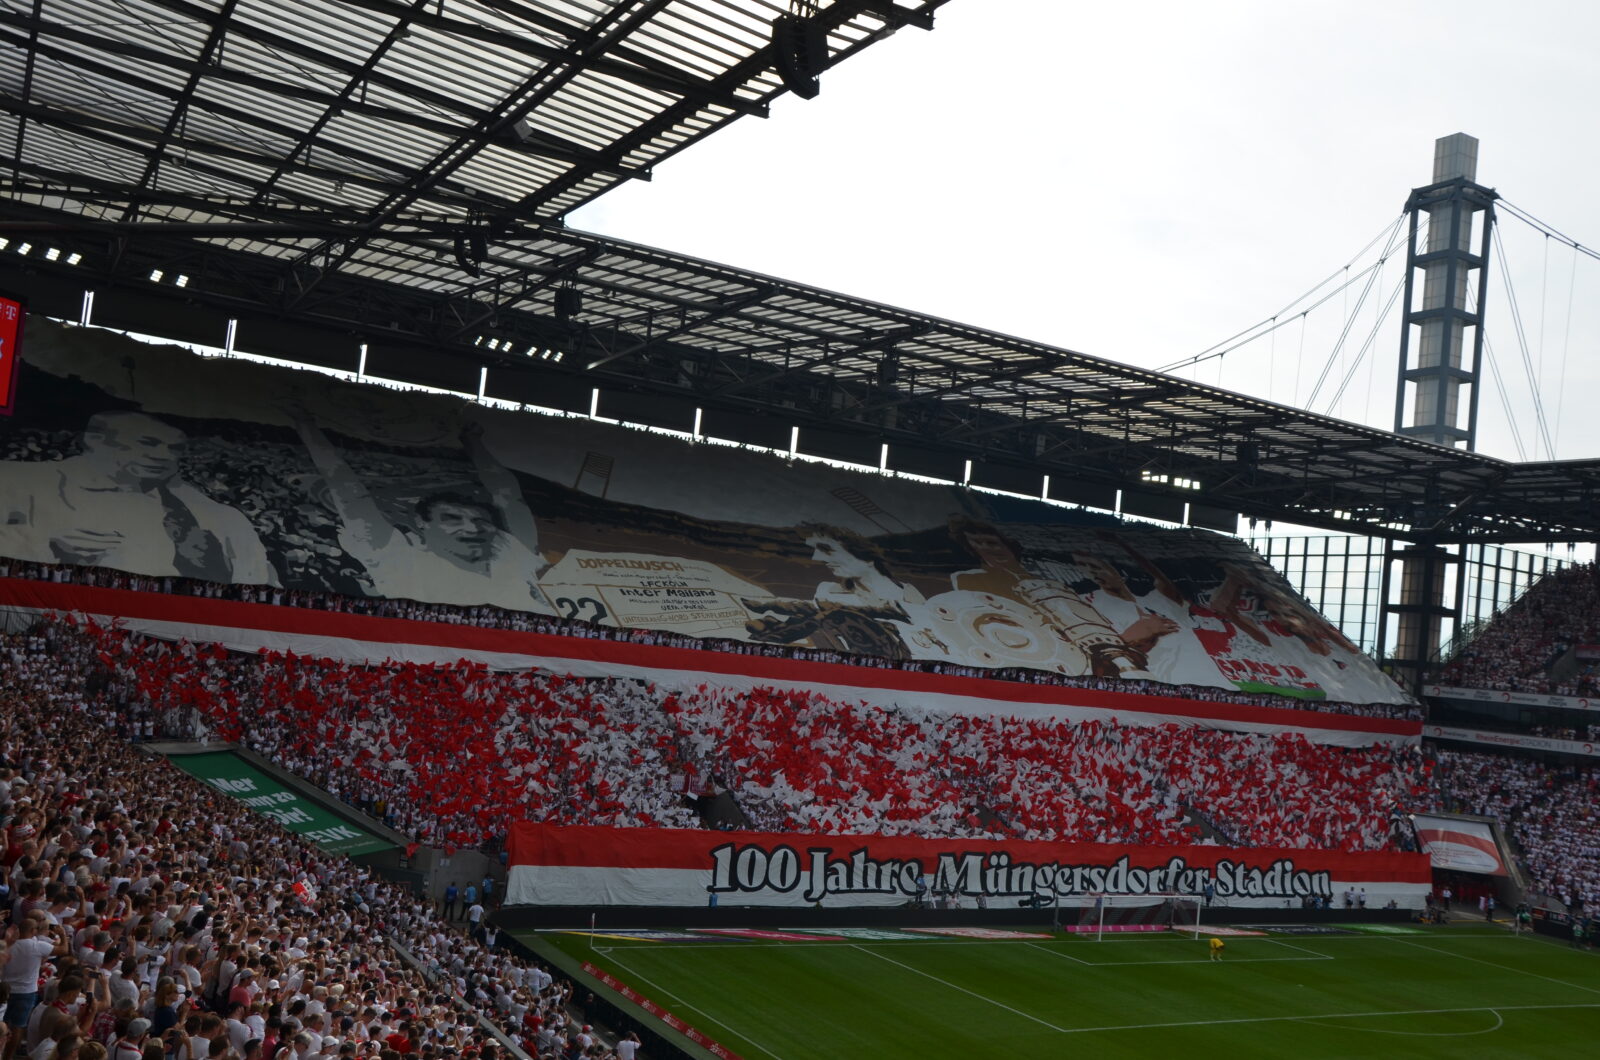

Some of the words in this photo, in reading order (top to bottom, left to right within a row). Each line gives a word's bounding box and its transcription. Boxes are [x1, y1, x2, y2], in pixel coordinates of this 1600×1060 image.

[576, 558, 684, 572] DOPPELDUSCH
[619, 588, 661, 597] Inter
[665, 588, 716, 598] Mailand
[206, 777, 258, 793] Mer
[270, 791, 297, 803] zo
[300, 825, 362, 843] EVK
[708, 843, 801, 892] 100
[804, 847, 927, 902] Jahre
[932, 851, 1210, 907] Müngersdorfer
[1216, 858, 1332, 898] Stadion
